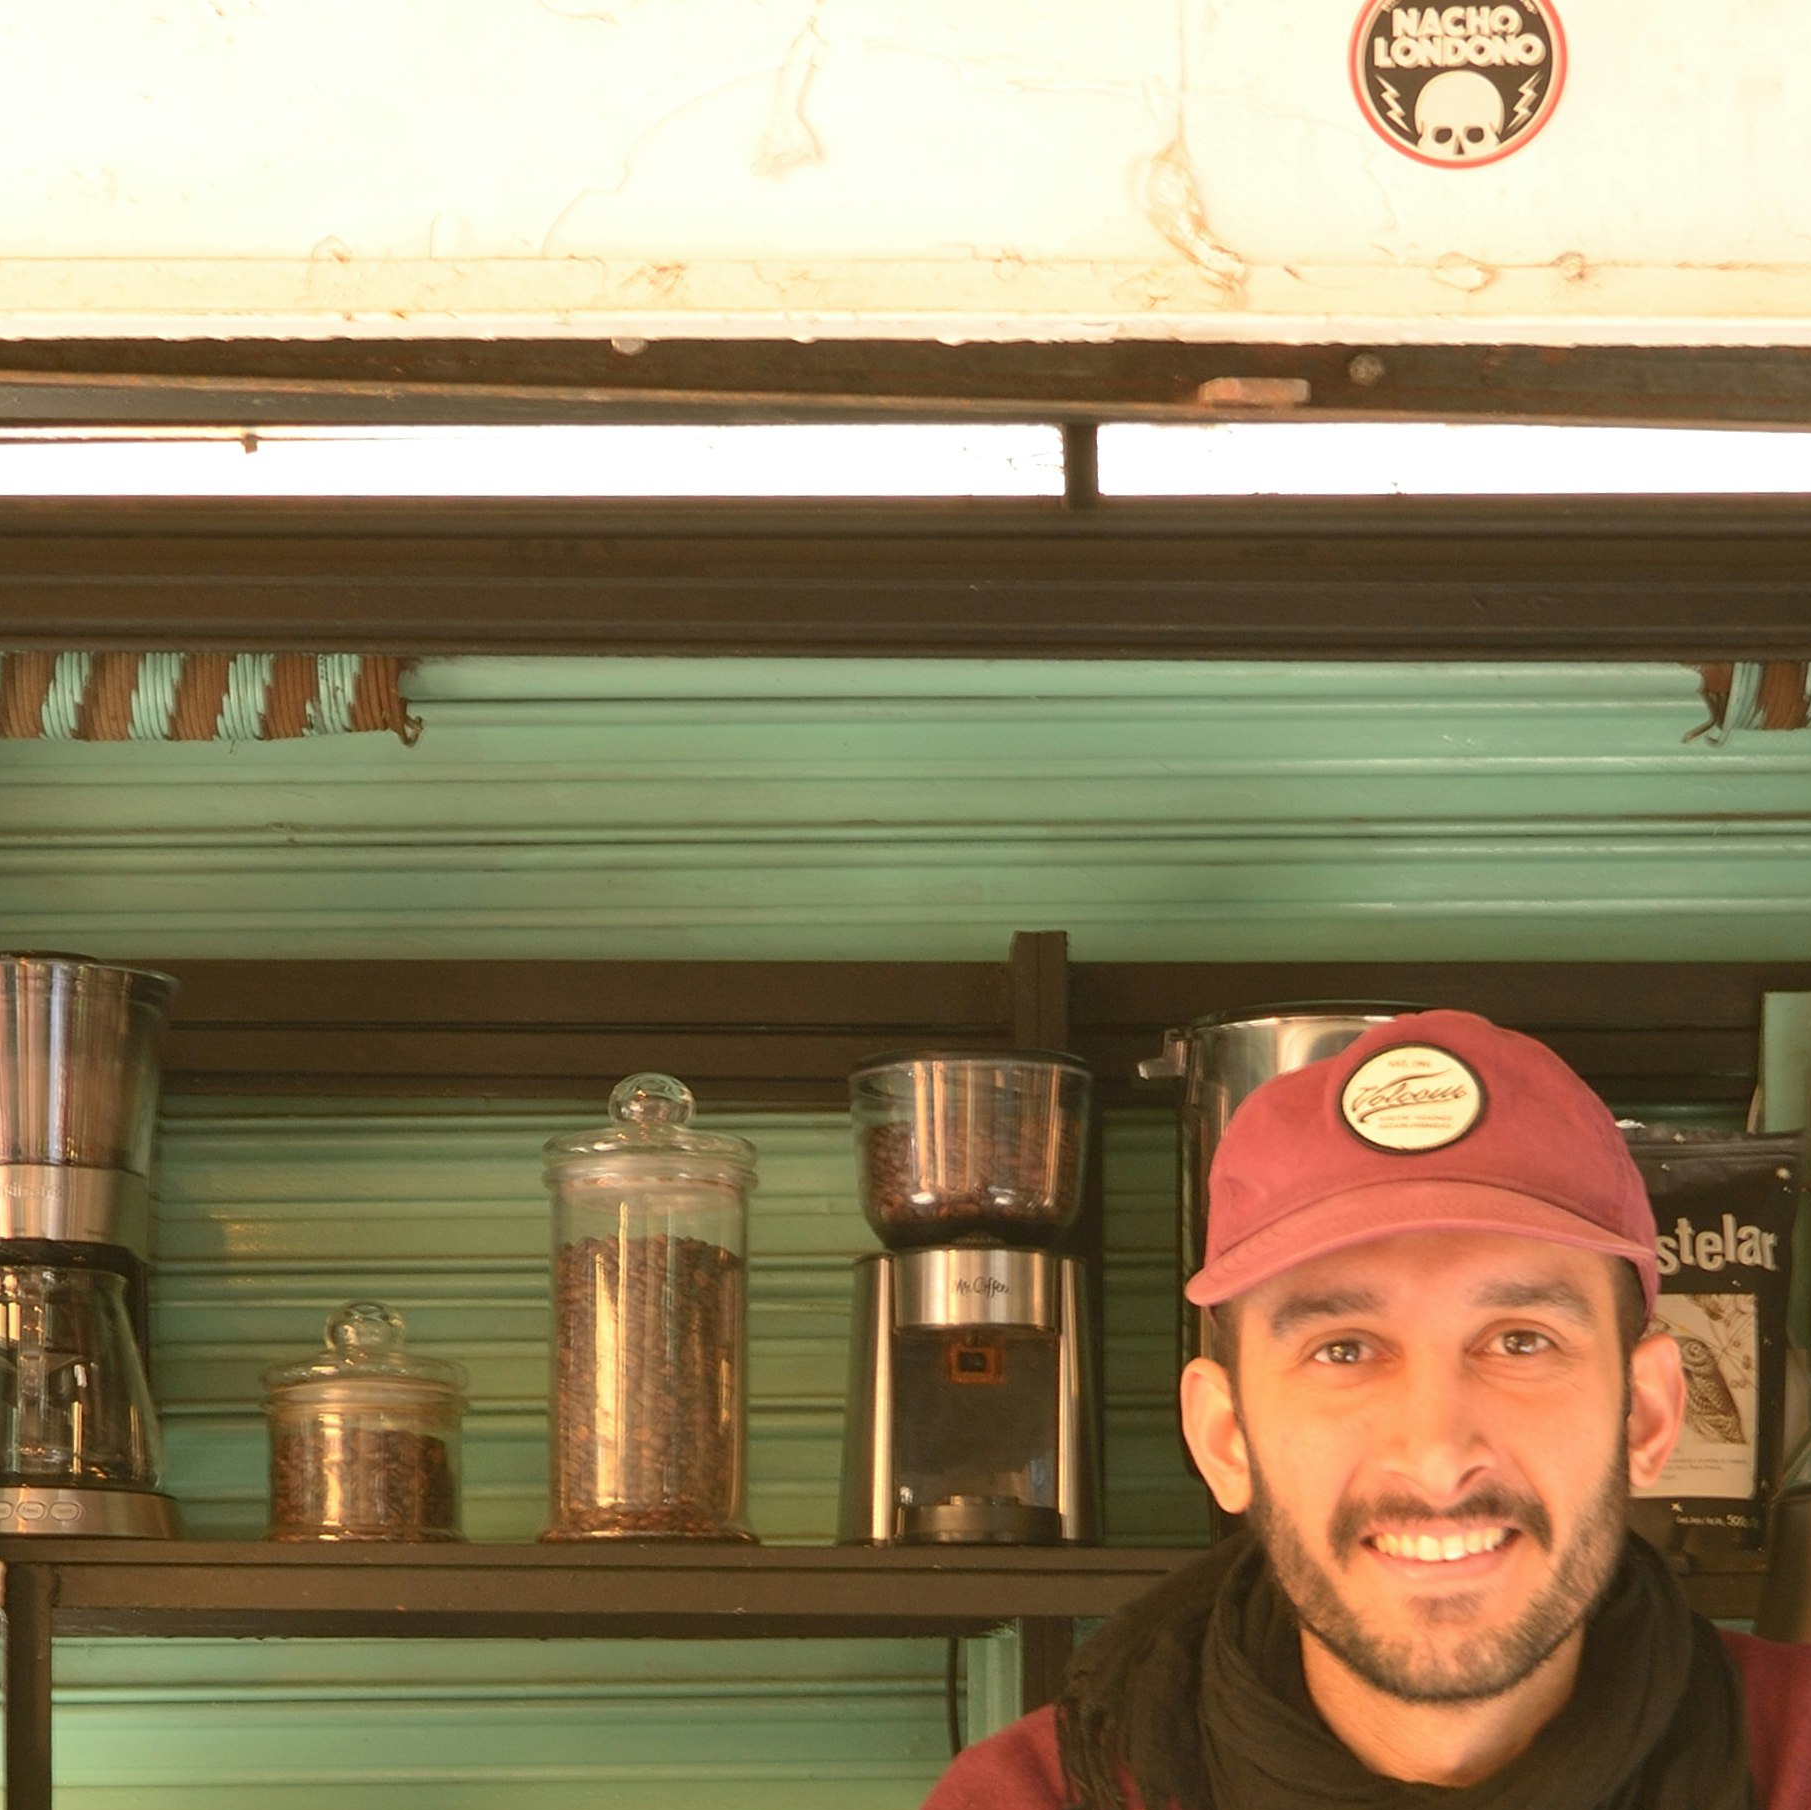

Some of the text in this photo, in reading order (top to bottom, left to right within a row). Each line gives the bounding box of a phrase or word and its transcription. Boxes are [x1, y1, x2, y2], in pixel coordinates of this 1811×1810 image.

[1392, 5, 1523, 37] NACHO
[1352, 1076, 1467, 1114] Volcom
[1656, 1213, 1778, 1276] stelar
